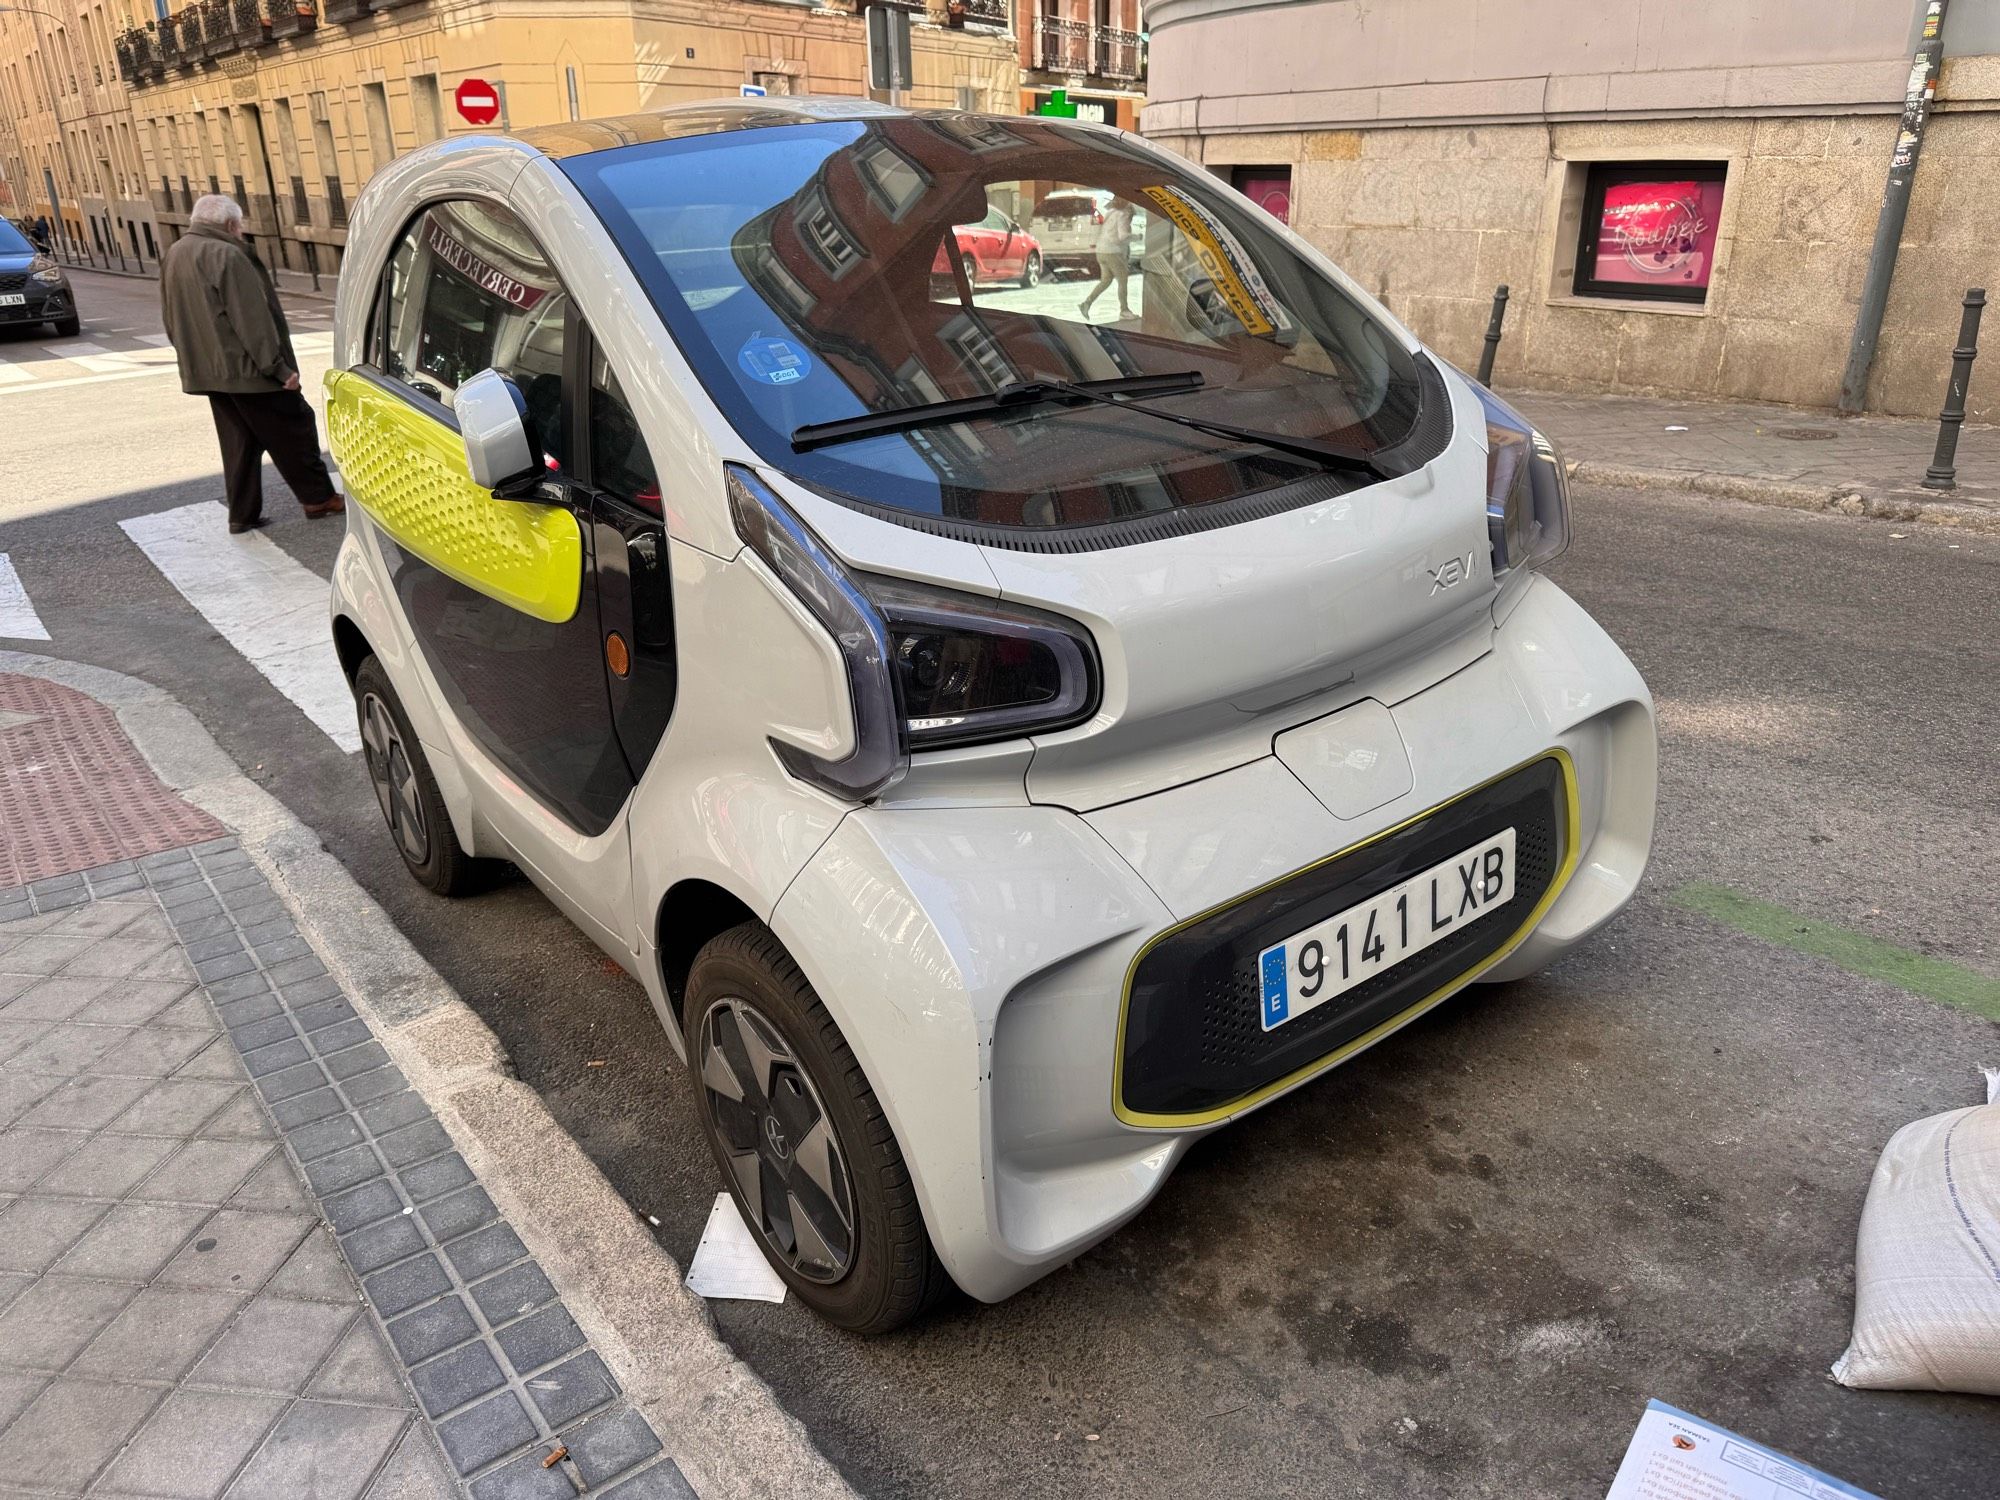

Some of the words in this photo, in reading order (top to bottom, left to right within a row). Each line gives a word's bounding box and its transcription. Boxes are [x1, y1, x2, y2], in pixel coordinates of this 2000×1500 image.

[1298, 893, 1408, 998] 9141
[1431, 846, 1504, 932] LXB
[1271, 993, 1281, 1012] E
